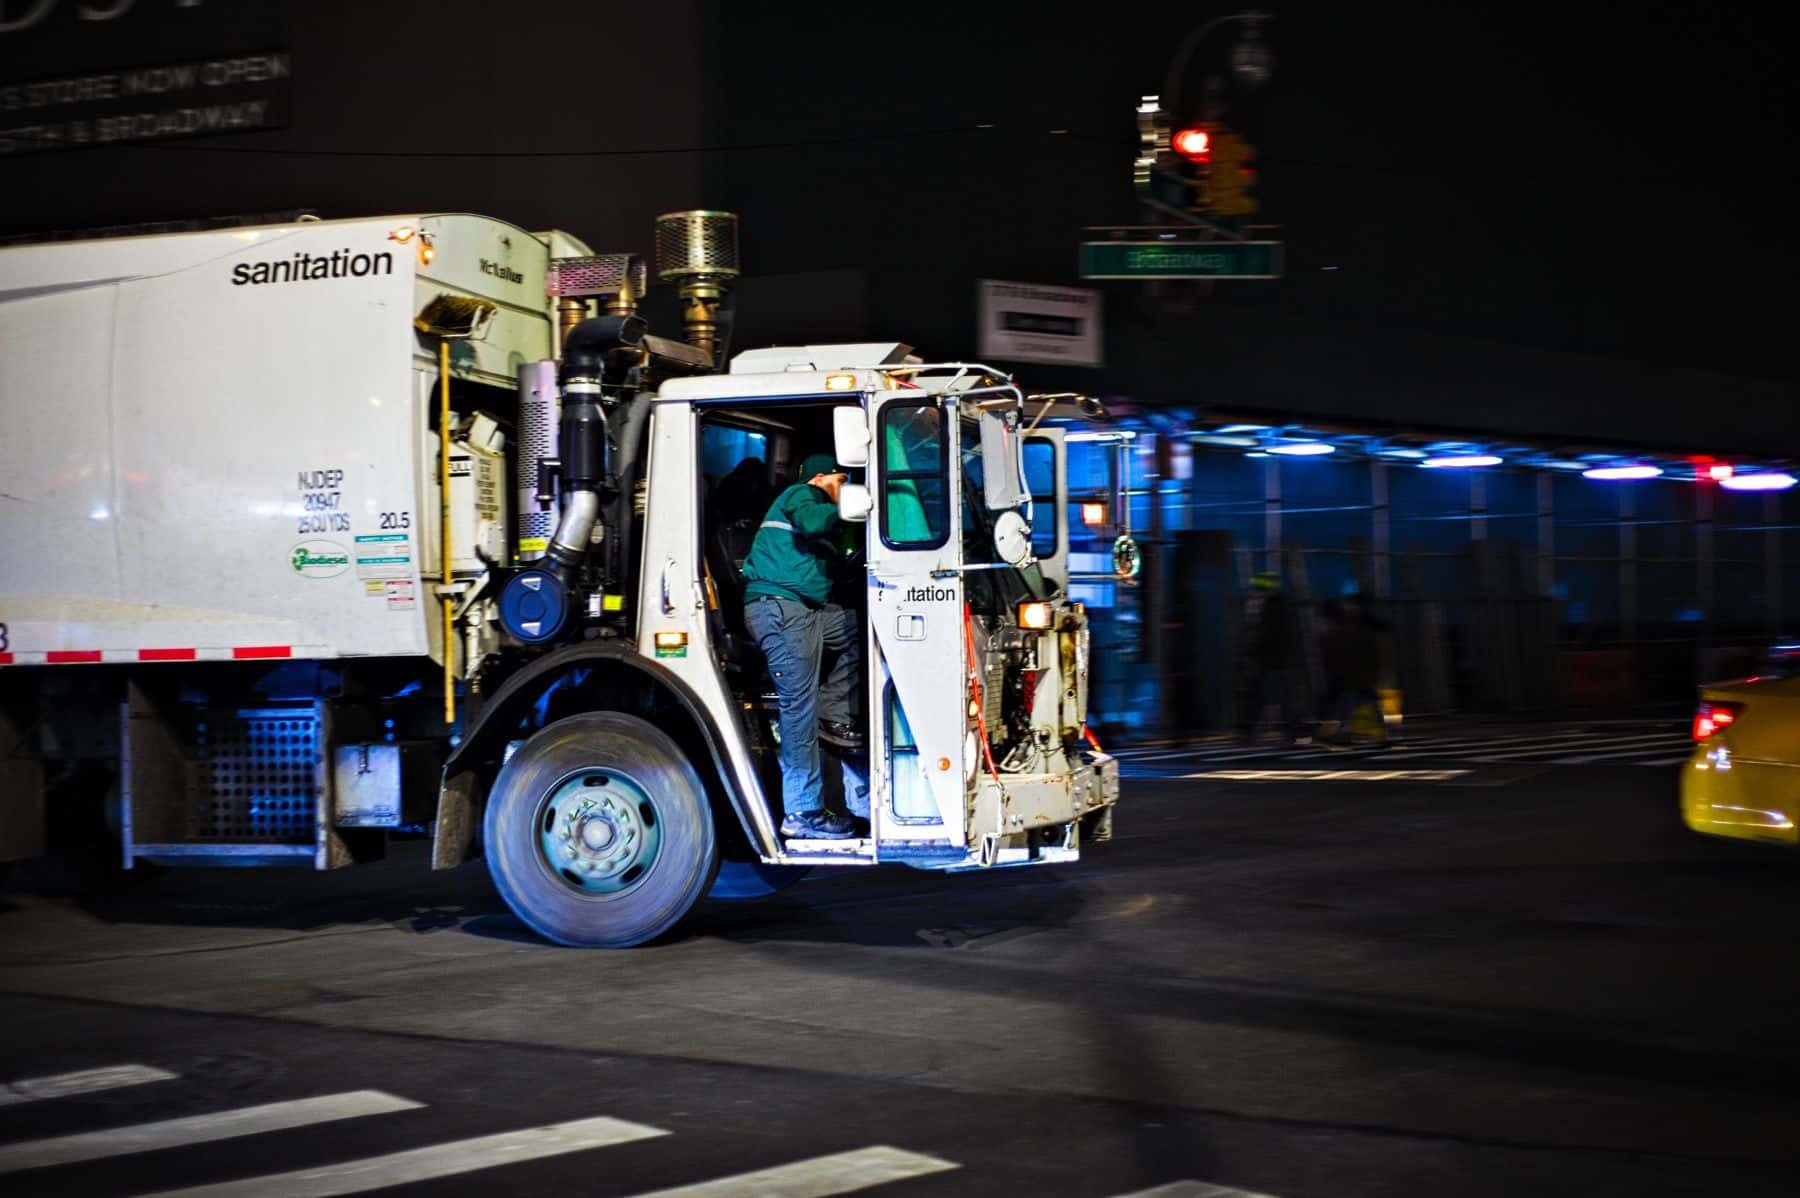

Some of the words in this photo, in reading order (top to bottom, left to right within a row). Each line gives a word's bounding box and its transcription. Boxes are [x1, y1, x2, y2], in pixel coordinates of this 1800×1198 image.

[27, 74, 120, 108] STORE
[122, 64, 199, 95] NOW
[201, 54, 290, 86] OPEN
[96, 99, 268, 142] BROADWAY
[231, 248, 393, 286] sanitation
[297, 468, 344, 490] NJDEP
[379, 511, 410, 530] 20.5
